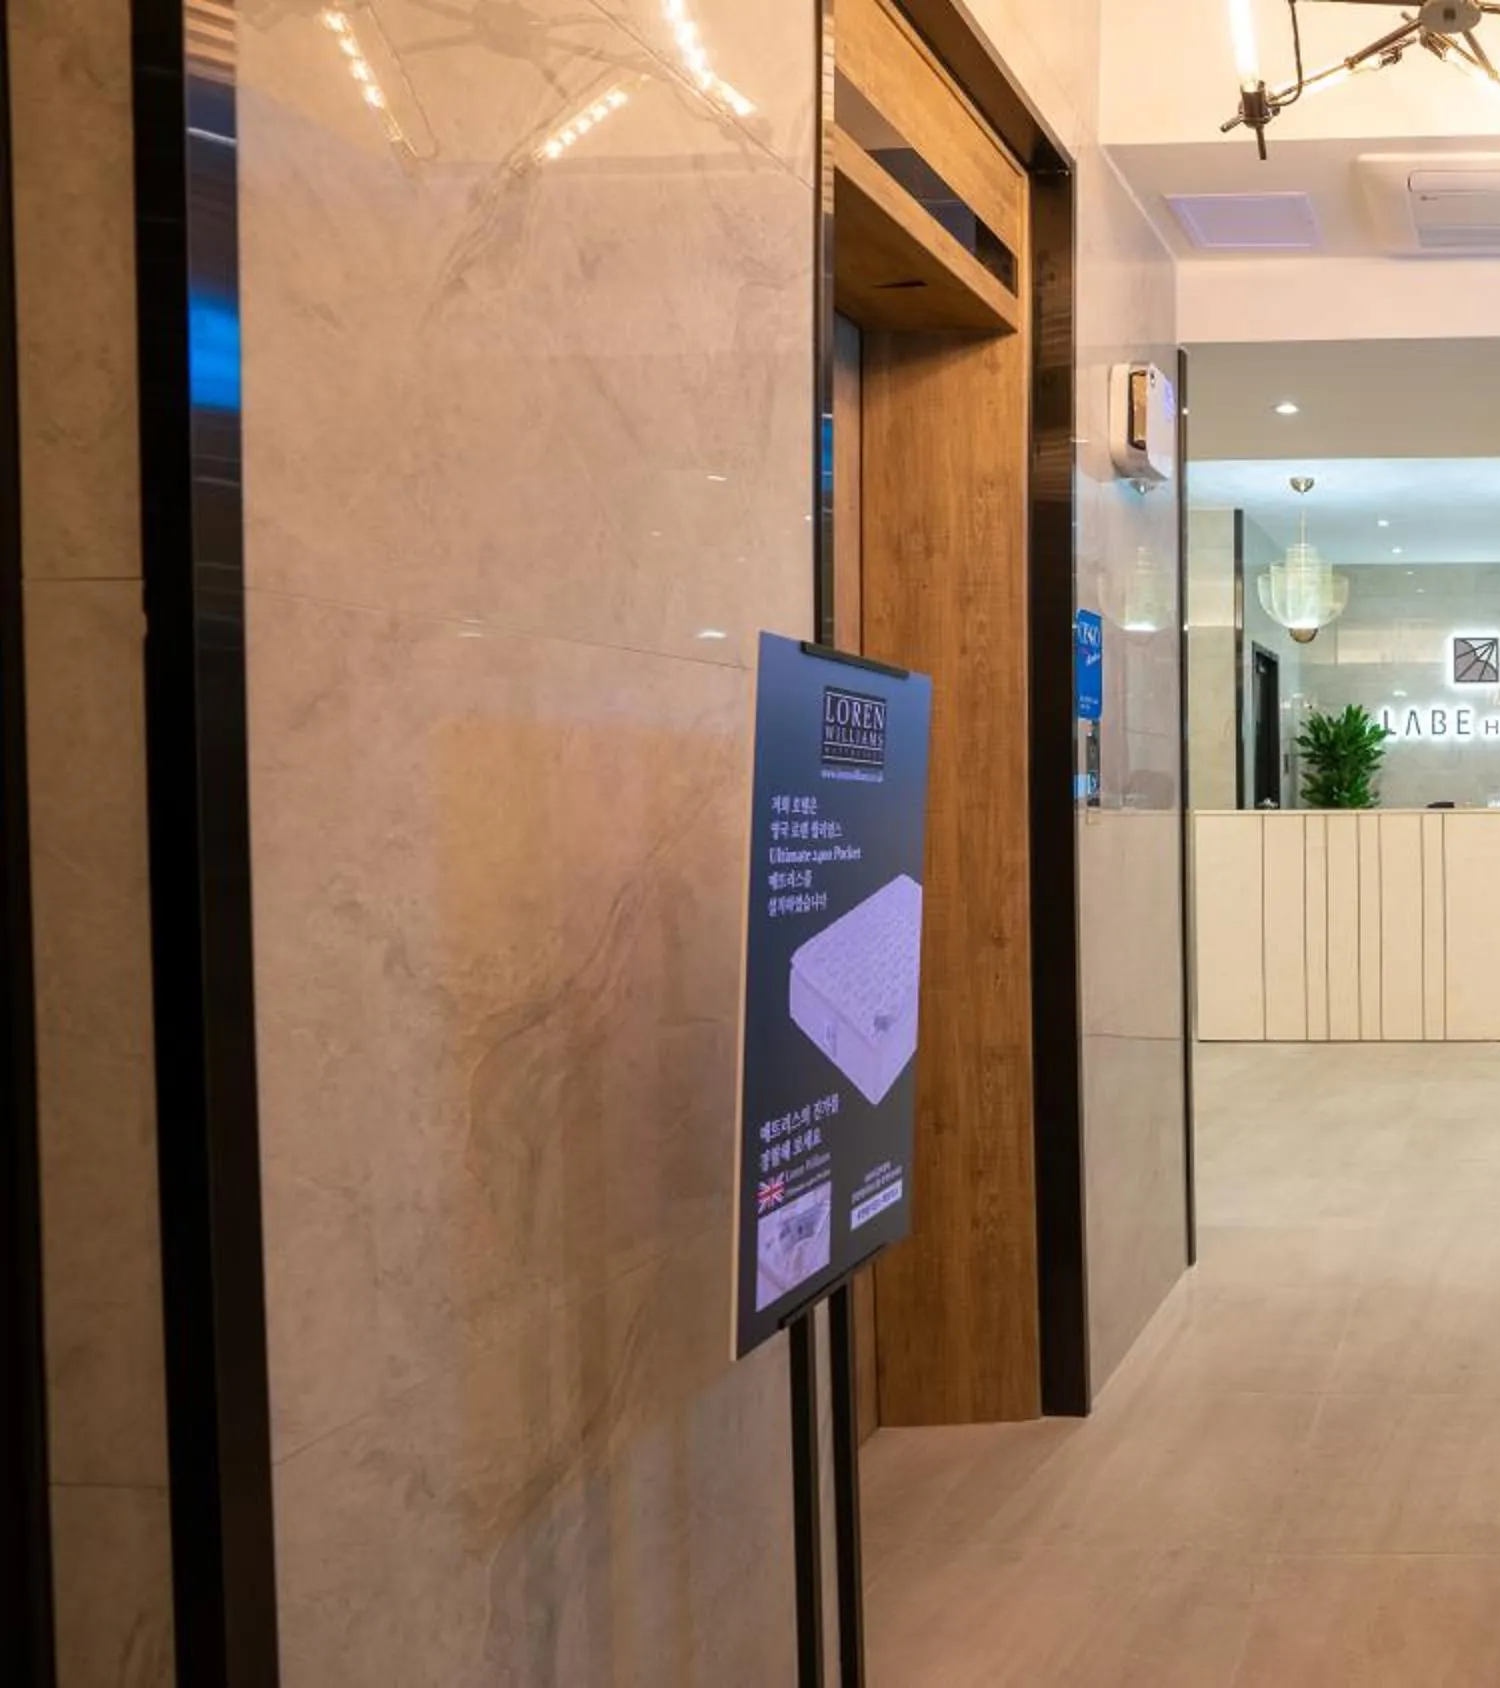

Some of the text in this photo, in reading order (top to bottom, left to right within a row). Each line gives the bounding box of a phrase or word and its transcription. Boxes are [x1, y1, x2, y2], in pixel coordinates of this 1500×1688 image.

[825, 696, 885, 729] LOREN
[1383, 710, 1471, 735] LABE
[825, 725, 884, 747] WILLIAMS
[769, 847, 810, 864] Ultimate
